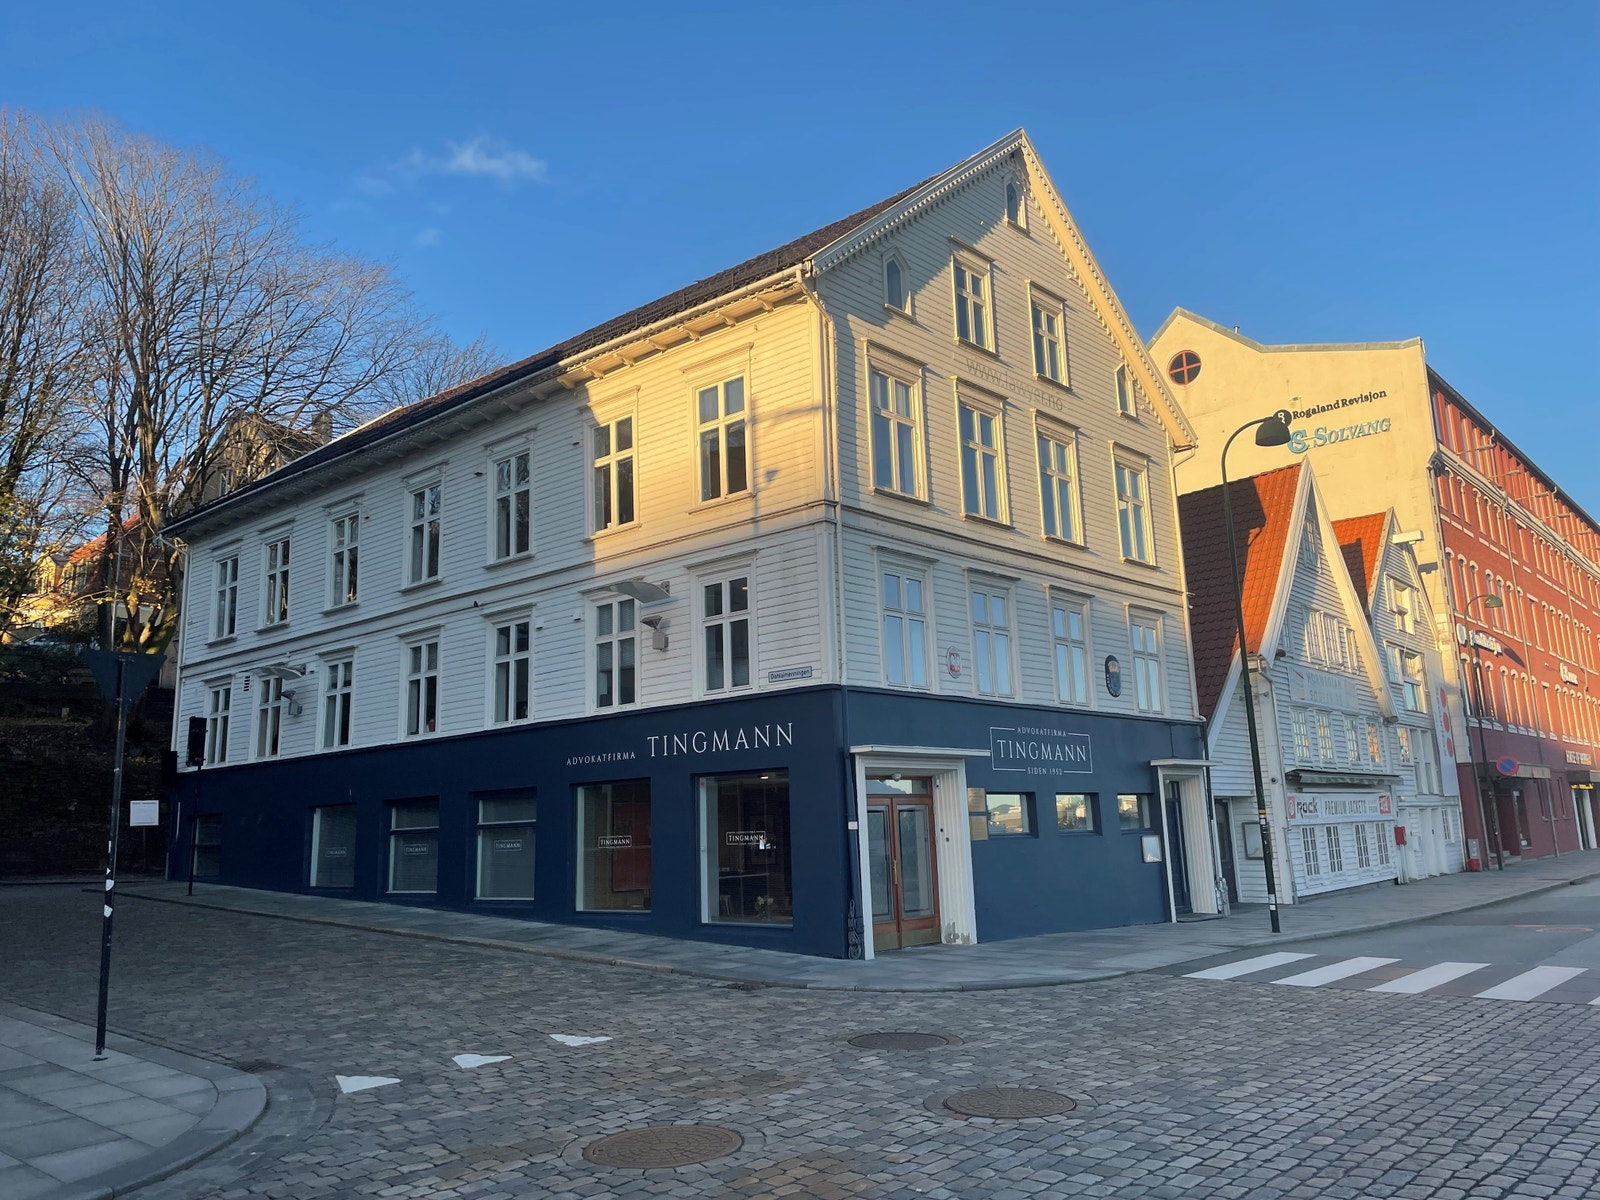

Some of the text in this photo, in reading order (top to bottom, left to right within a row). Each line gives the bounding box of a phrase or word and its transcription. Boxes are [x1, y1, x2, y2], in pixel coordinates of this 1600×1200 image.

[1292, 389, 1387, 420] Rogaland Revisjon
[1314, 417, 1391, 447] SOLVANG
[1017, 726, 1067, 737] ADVOKATFIRMA
[566, 722, 794, 766] ADVOKATFIRMA TINGMANN
[996, 739, 1087, 762] TINGMANN
[1027, 767, 1063, 776] SIDEN 1952
[600, 838, 630, 846] TINGMANN
[728, 834, 764, 842] TINGMANN
[495, 841, 521, 850] TINGMANN
